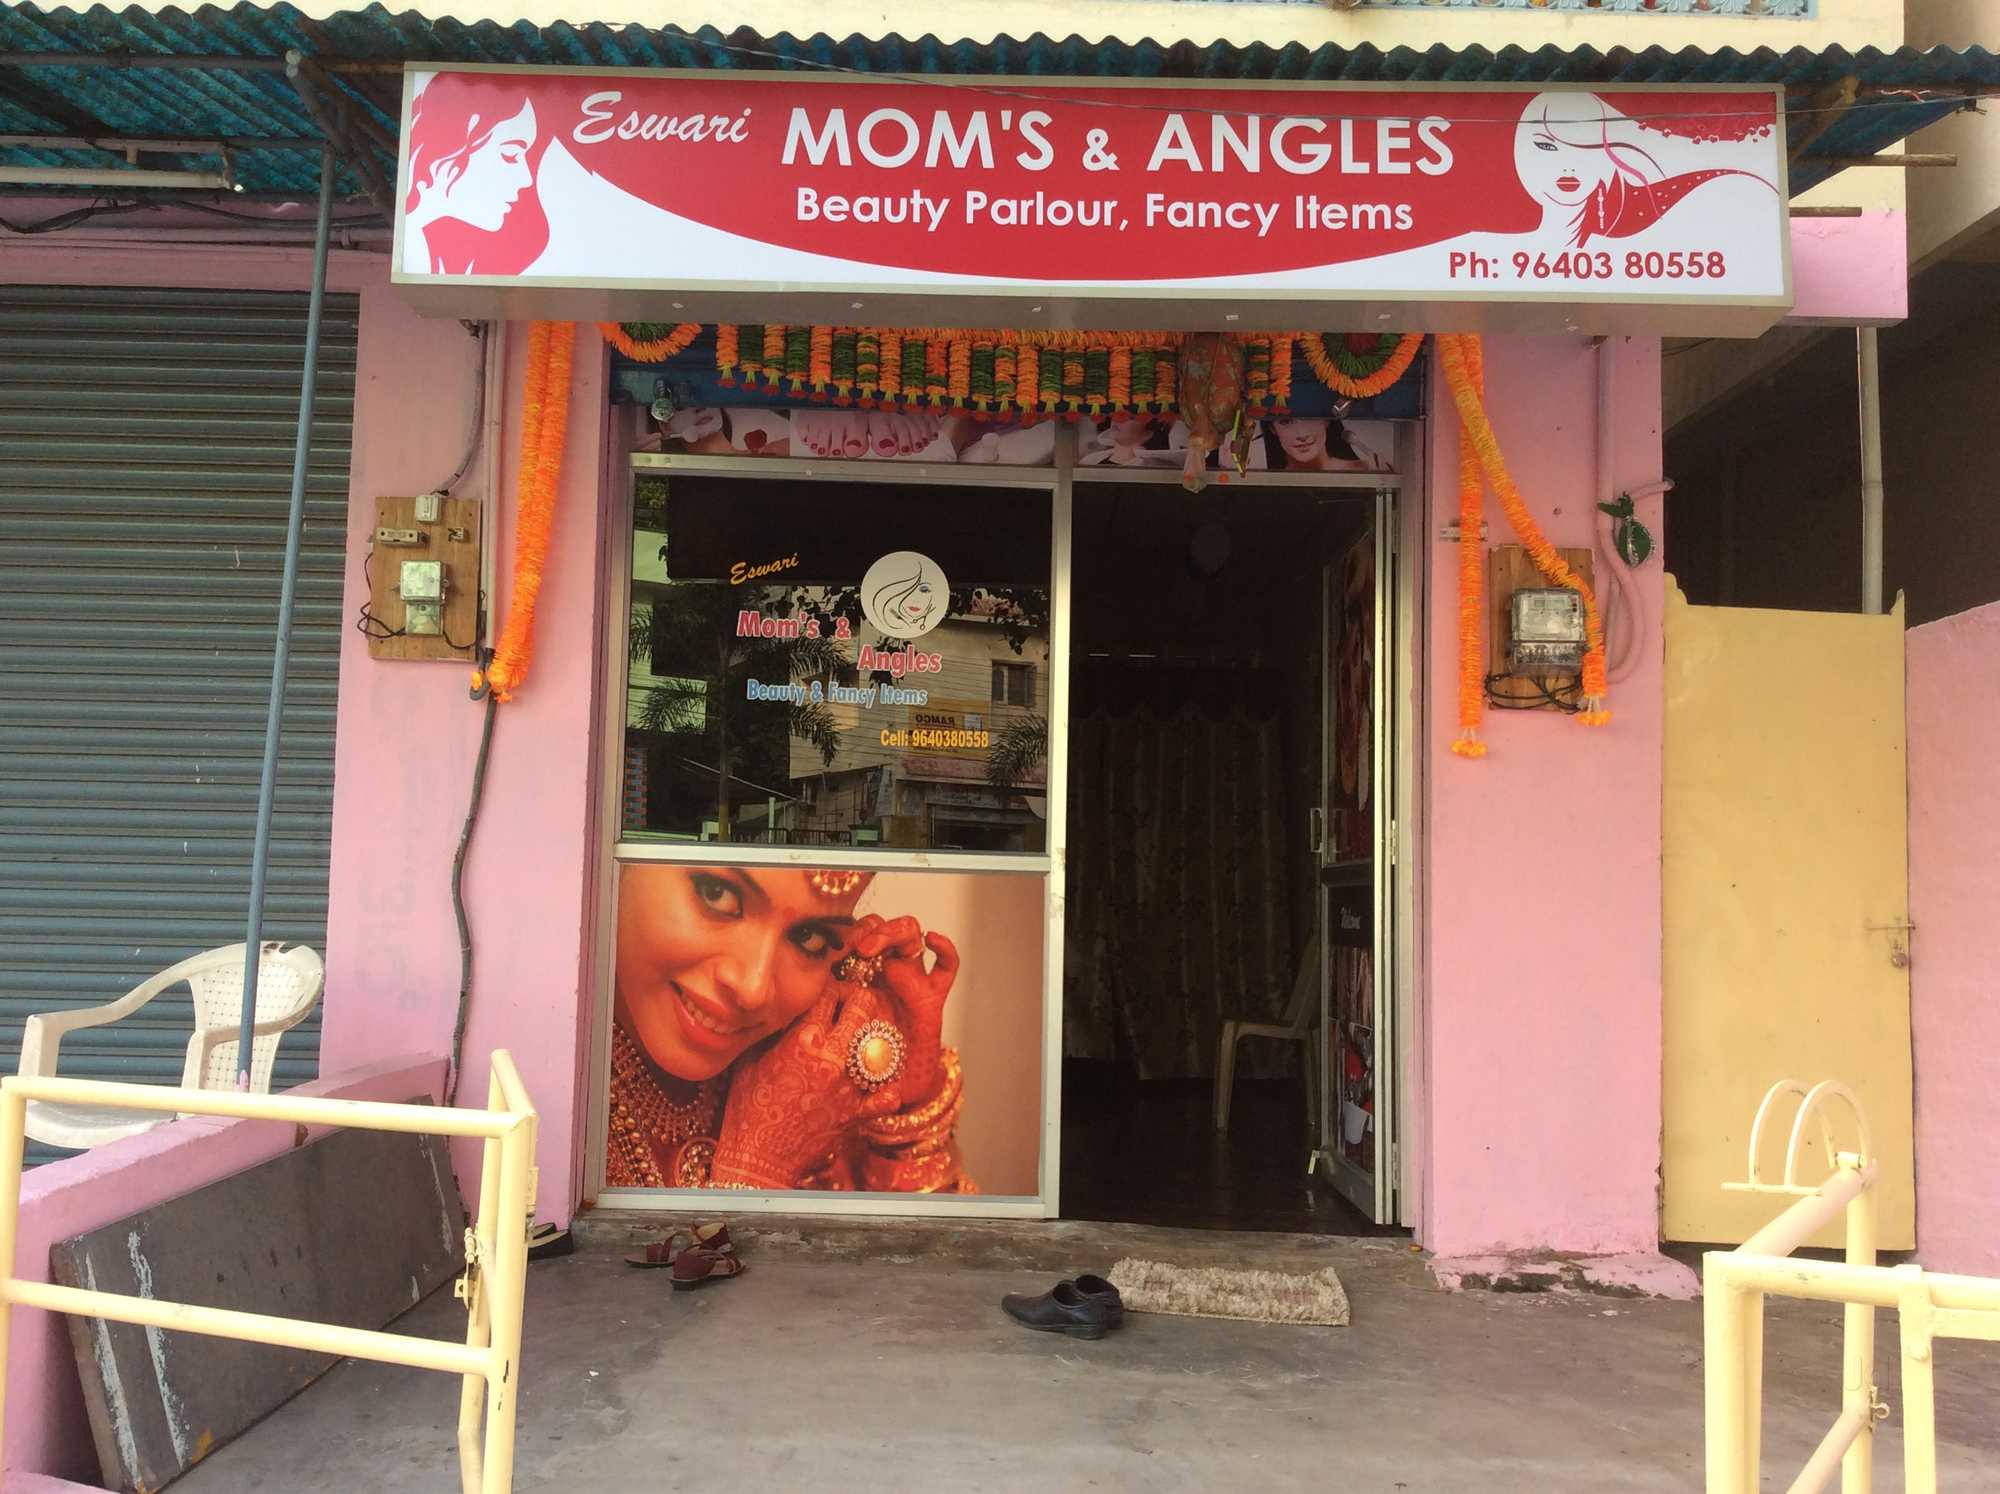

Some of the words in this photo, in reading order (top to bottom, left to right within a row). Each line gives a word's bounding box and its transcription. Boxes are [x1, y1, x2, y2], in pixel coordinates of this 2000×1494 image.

[572, 91, 752, 145] Eswari
[781, 107, 1054, 171] MOM'S
[1083, 128, 1119, 171] &
[1146, 113, 1454, 176] ANGLES
[796, 187, 950, 232] Beauty
[966, 189, 1129, 232] Parlour,
[1146, 193, 1280, 237] Fancy
[1296, 195, 1413, 231] Items
[1449, 252, 1499, 279] Ph:
[1512, 252, 1613, 280] 96403
[1625, 252, 1726, 280] 80558
[730, 552, 799, 585] Eswari
[737, 610, 819, 639] Mom's
[834, 616, 852, 640] &
[857, 644, 943, 678] Angles
[746, 679, 805, 706] Beauty
[810, 681, 824, 703] &
[828, 682, 877, 709] Fancy
[880, 684, 928, 705] Items
[880, 729, 909, 747] Cell:
[911, 729, 990, 748] 9640380558
